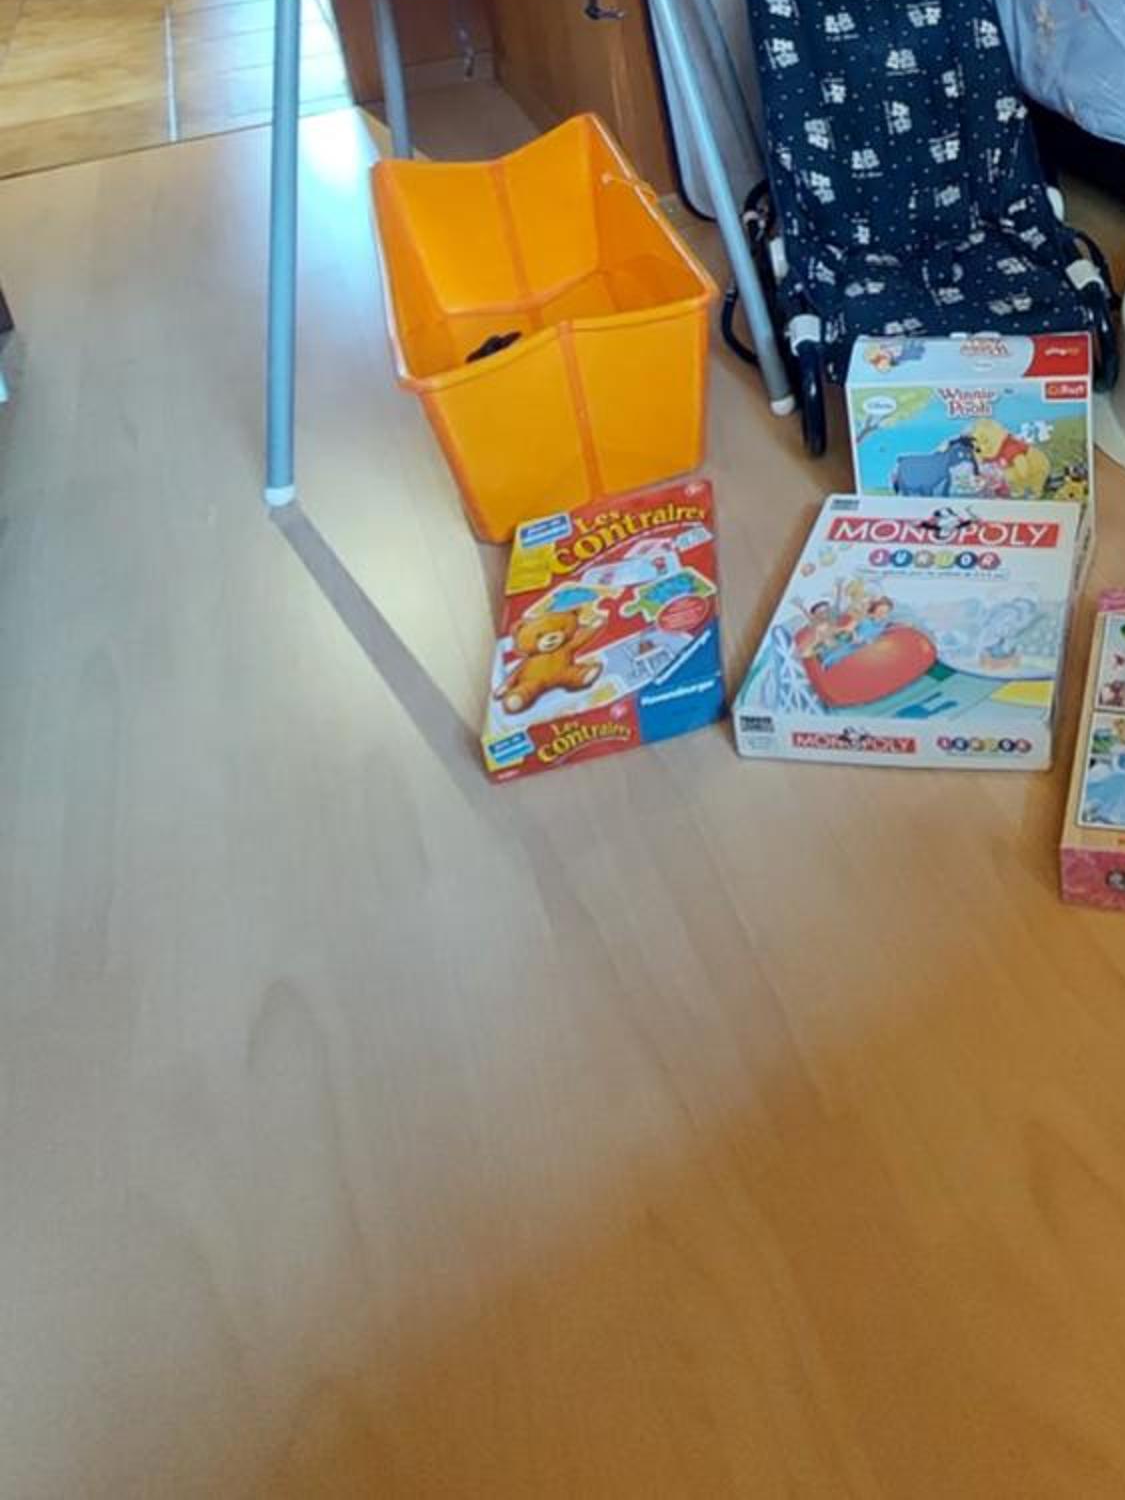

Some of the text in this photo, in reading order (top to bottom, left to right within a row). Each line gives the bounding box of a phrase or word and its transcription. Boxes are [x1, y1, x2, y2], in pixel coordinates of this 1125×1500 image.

[575, 509, 620, 534] Les
[835, 520, 1050, 546] MONOPOLY
[870, 550, 1001, 570] JUNIOR
